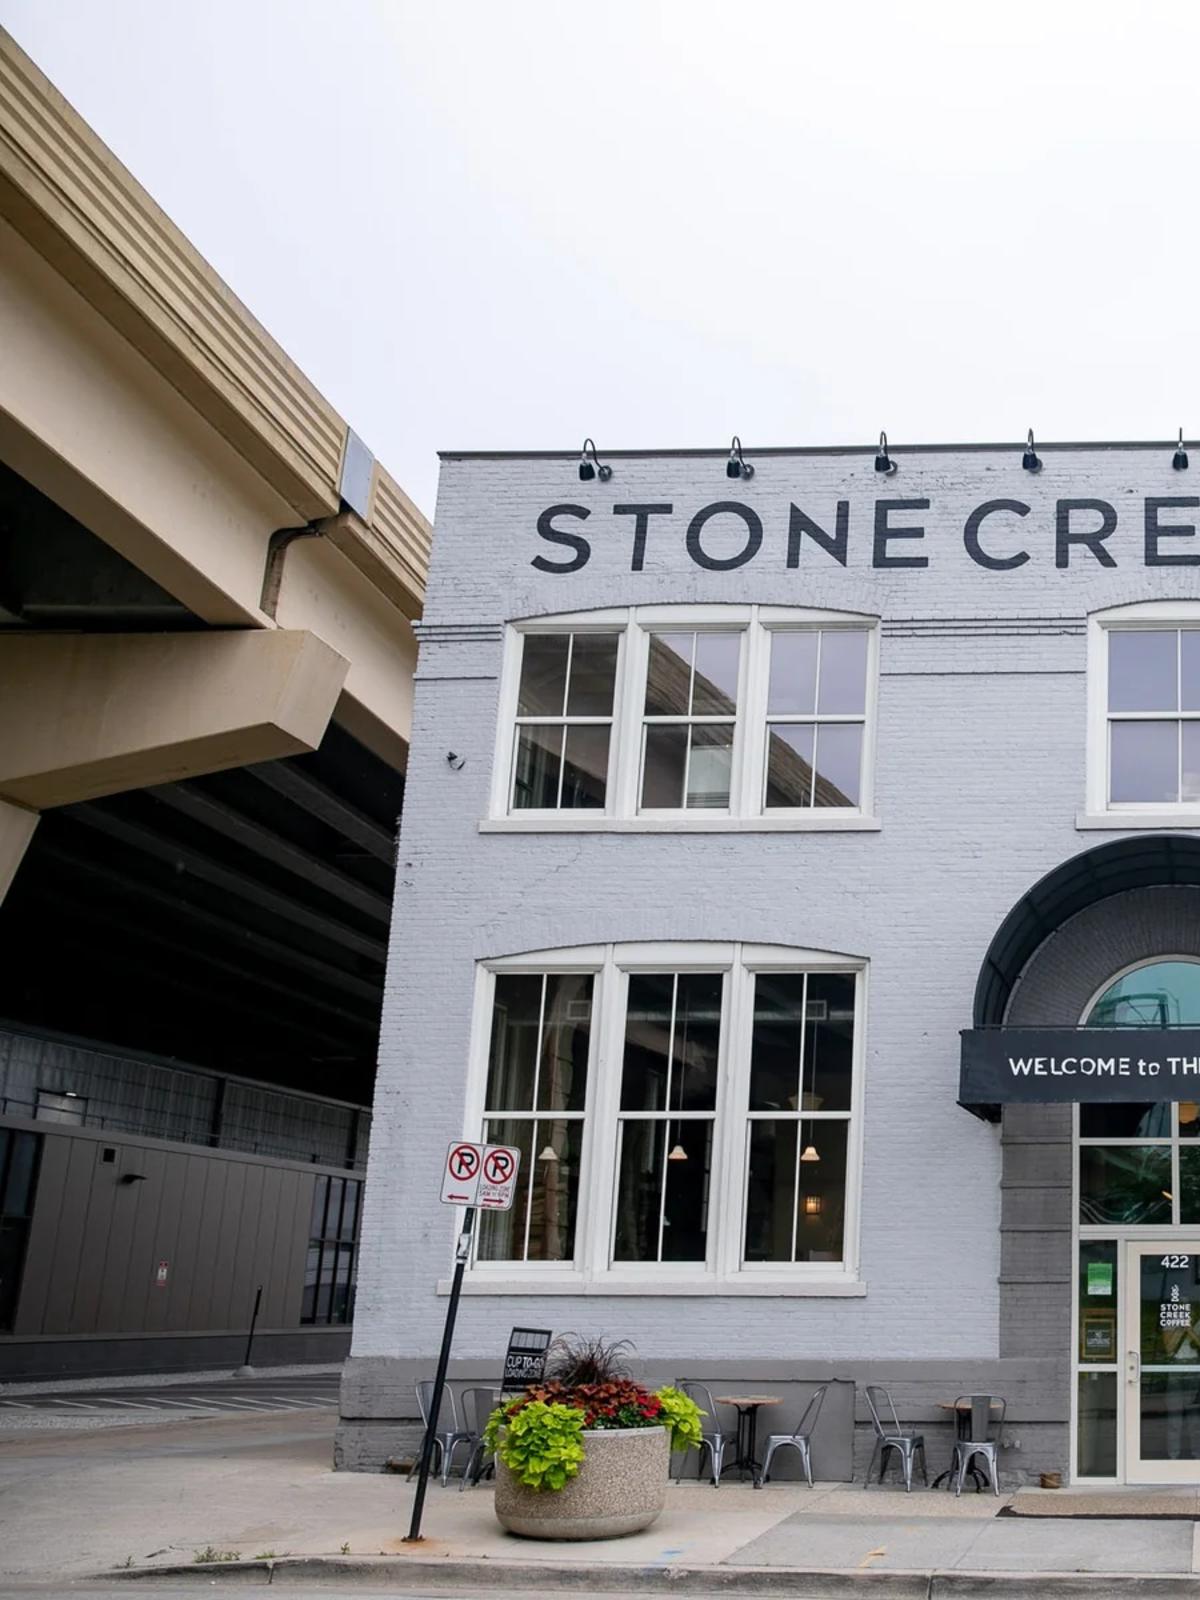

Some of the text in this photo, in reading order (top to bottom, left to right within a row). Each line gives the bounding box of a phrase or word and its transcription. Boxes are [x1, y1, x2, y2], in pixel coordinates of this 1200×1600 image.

[1008, 1057, 1131, 1076] WELCOME
[1138, 1060, 1161, 1076] to
[1161, 1255, 1189, 1269] 422
[1160, 1304, 1191, 1312] STONE
[1160, 1319, 1191, 1327] COFFEE
[507, 1356, 522, 1368] CUP
